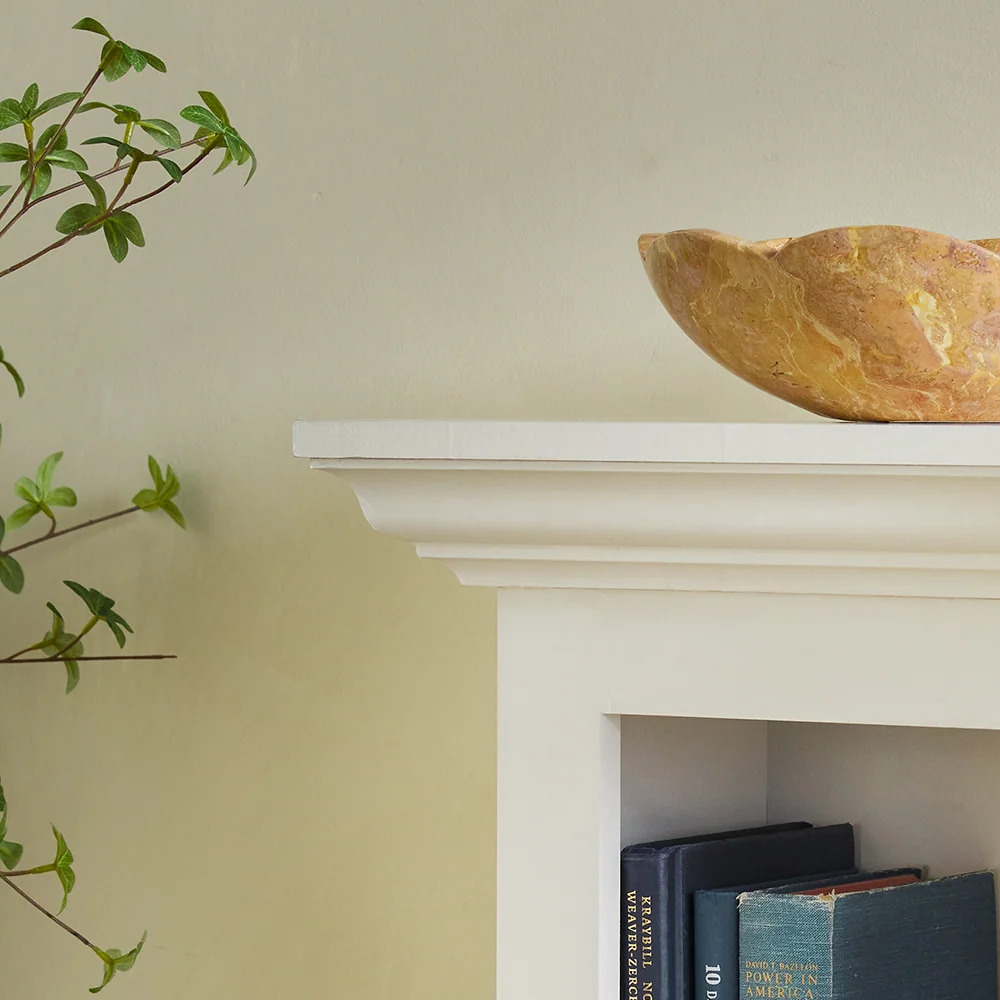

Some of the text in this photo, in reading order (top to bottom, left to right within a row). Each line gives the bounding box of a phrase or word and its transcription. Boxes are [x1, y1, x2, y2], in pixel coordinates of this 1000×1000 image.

[641, 896, 653, 969] KRAYBILL
[745, 961, 769, 969] DAVID
[779, 963, 819, 971] BAZELON
[705, 964, 722, 986] 10
[745, 971, 818, 985] POWER IN
[745, 986, 814, 1000] AMERICA
